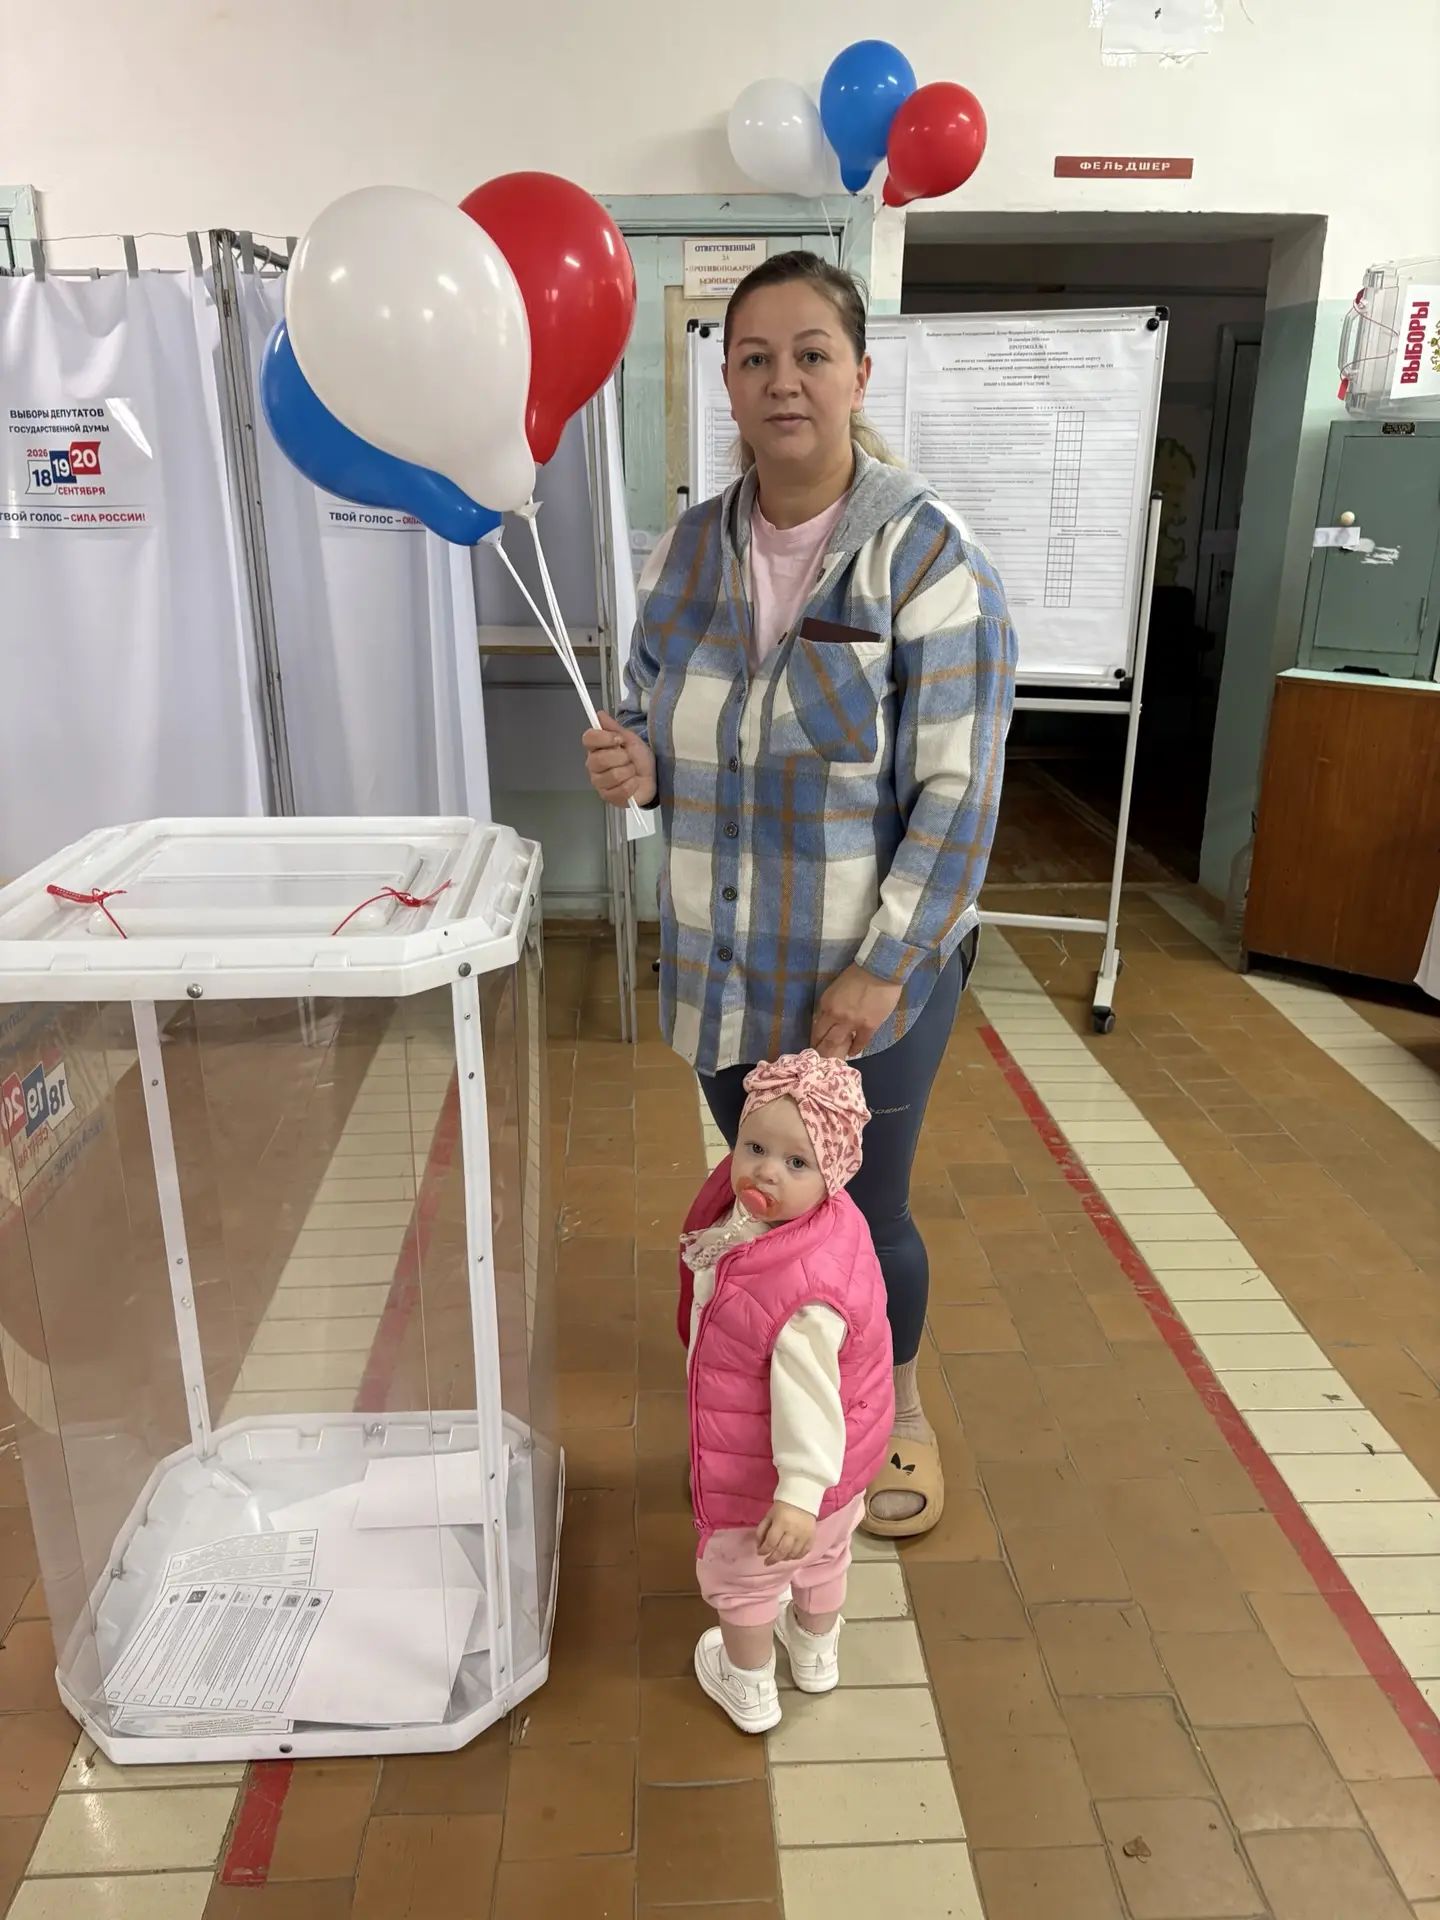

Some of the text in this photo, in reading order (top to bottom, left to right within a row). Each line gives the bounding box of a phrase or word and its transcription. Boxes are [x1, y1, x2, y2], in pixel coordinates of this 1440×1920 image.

[1079, 161, 1171, 171] ФЕЛЬДШЕР
[694, 243, 756, 252] ОТВЕТСТВЕННЫЙ
[1400, 301, 1430, 384] ВЫБОРЫ
[10, 408, 104, 419] ВЫБОРЫ ДЕПУТАТОВ
[9, 424, 110, 434] ГОСУДАРСТВЕННОЙ ДУМЫ
[26, 448, 48, 458] 2026
[32, 449, 97, 487] 18 19 20
[57, 486, 106, 496] СЕНТЯБРЯ
[30, 512, 62, 522] ГОЛОС
[70, 513, 97, 522] СИЛА
[98, 512, 146, 522] РОССИИ!
[329, 511, 356, 522] ТВОЙ
[359, 514, 393, 524] ГОЛОС
